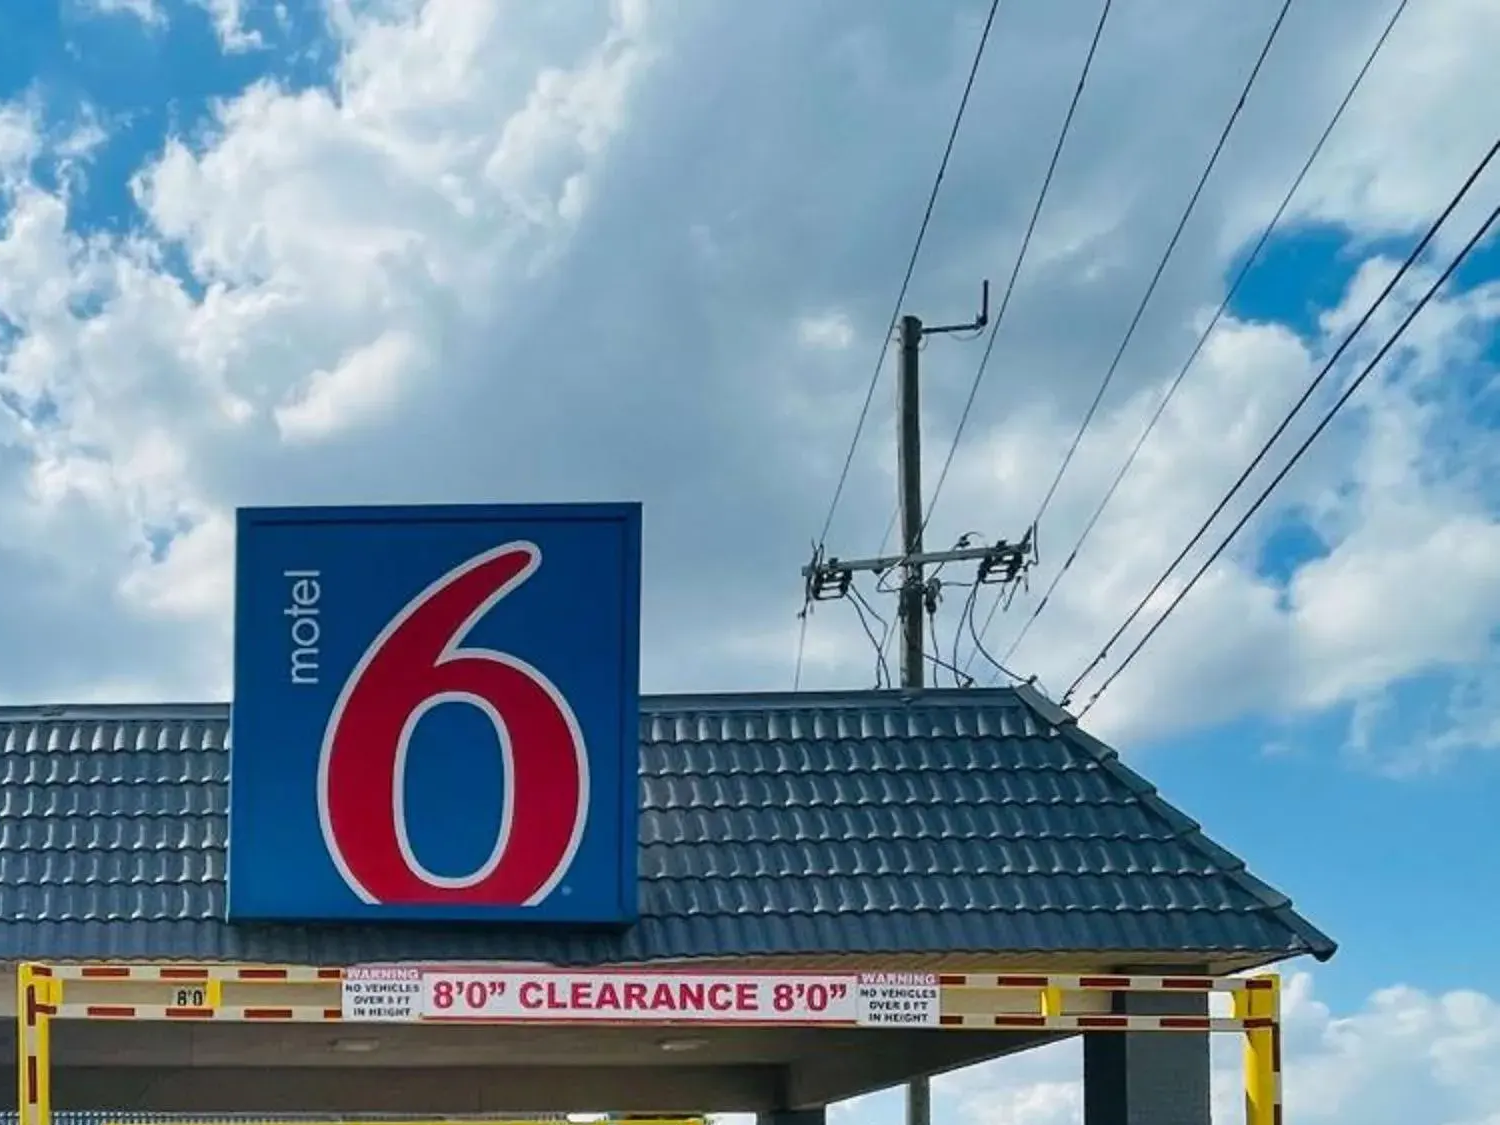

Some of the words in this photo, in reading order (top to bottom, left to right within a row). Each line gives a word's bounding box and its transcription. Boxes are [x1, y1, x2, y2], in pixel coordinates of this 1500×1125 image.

[284, 570, 321, 684] motel
[317, 540, 590, 907] 6
[347, 966, 419, 980] WARNING
[861, 973, 936, 985] WARNING
[345, 983, 362, 992] NO
[365, 983, 419, 992] VEHICLES
[519, 981, 759, 1011] CLEARANCE
[860, 988, 877, 997] NO
[881, 988, 936, 998] VEHICLES
[354, 995, 384, 1004] OVER
[397, 995, 410, 1004] FT
[869, 1001, 900, 1010] OVER
[913, 1001, 928, 1010] FT
[353, 1007, 365, 1016] IN
[369, 1007, 410, 1016] HEIGHT
[869, 1013, 881, 1022] IN
[884, 1013, 928, 1022] HEIGHT
